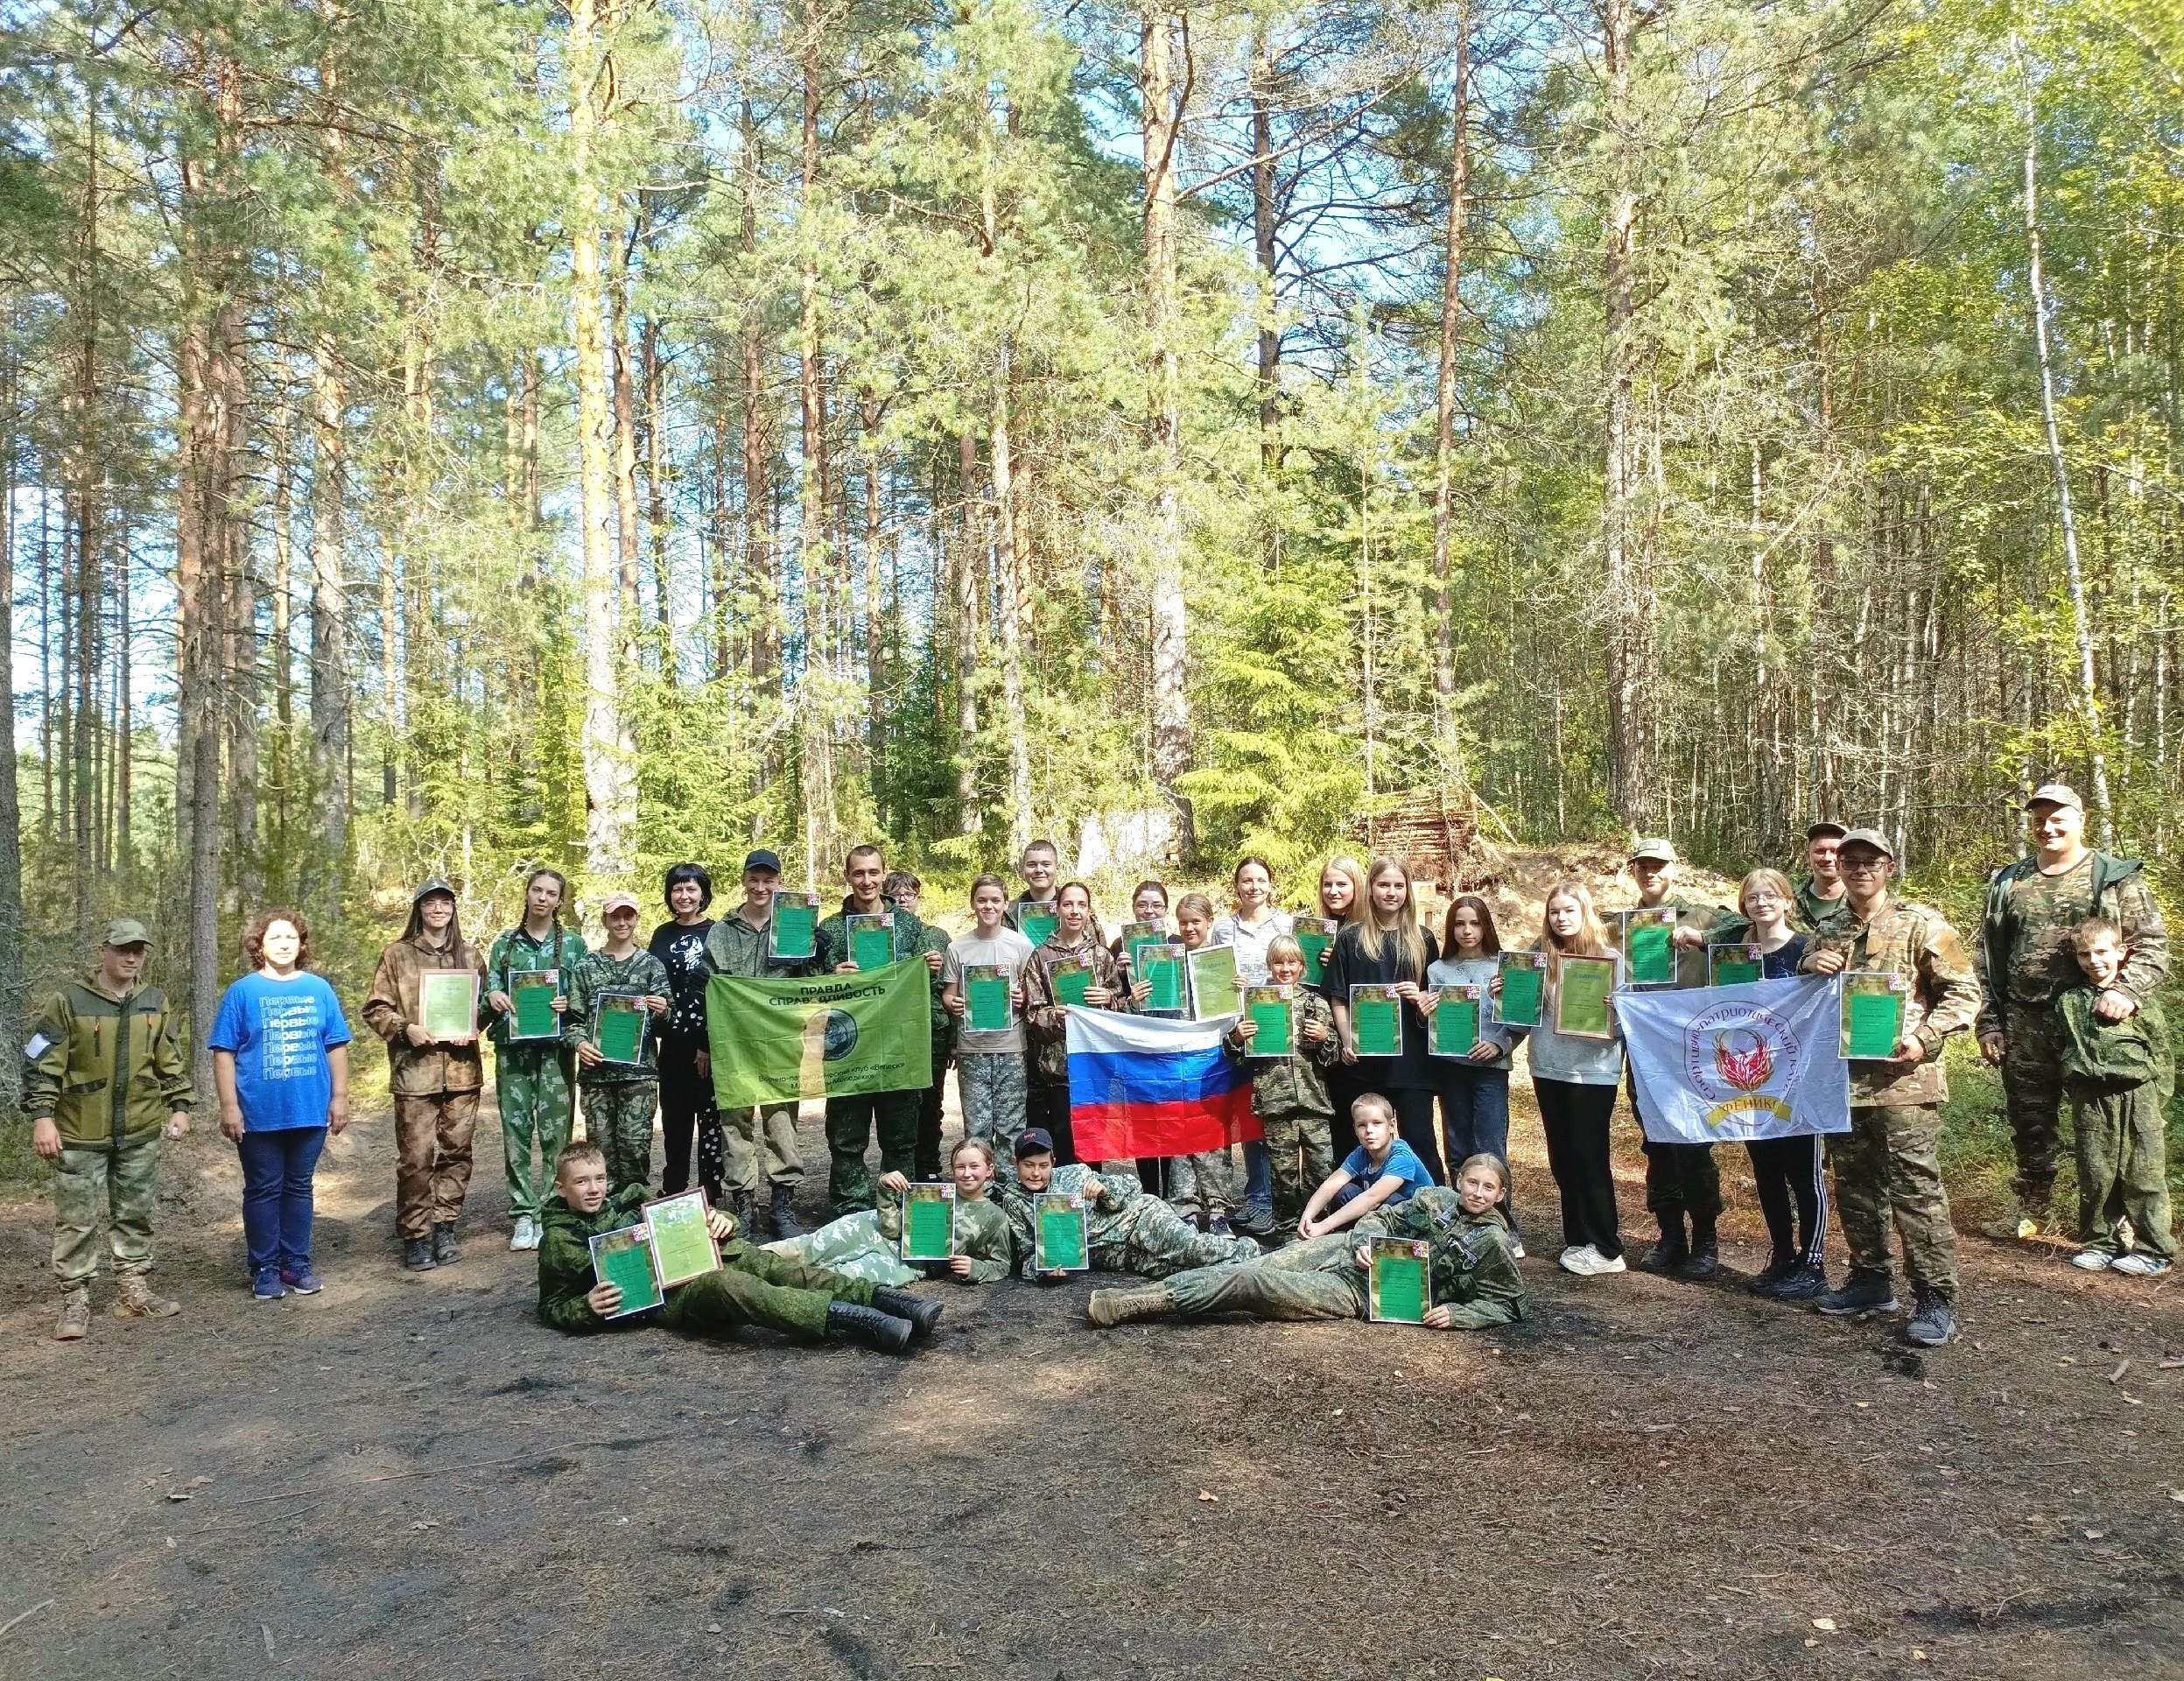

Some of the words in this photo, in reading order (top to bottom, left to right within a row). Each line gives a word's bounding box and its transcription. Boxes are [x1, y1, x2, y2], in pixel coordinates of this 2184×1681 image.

[800, 982, 853, 995] ПРАВДА
[259, 995, 315, 1008] Первые
[261, 1006, 317, 1018] Первые
[263, 1016, 319, 1031] Первые
[263, 1029, 318, 1044] Первые
[263, 1041, 318, 1056] Первые
[263, 1053, 318, 1068] Первые
[263, 1066, 317, 1081] Первые
[852, 1065, 869, 1073] клуб
